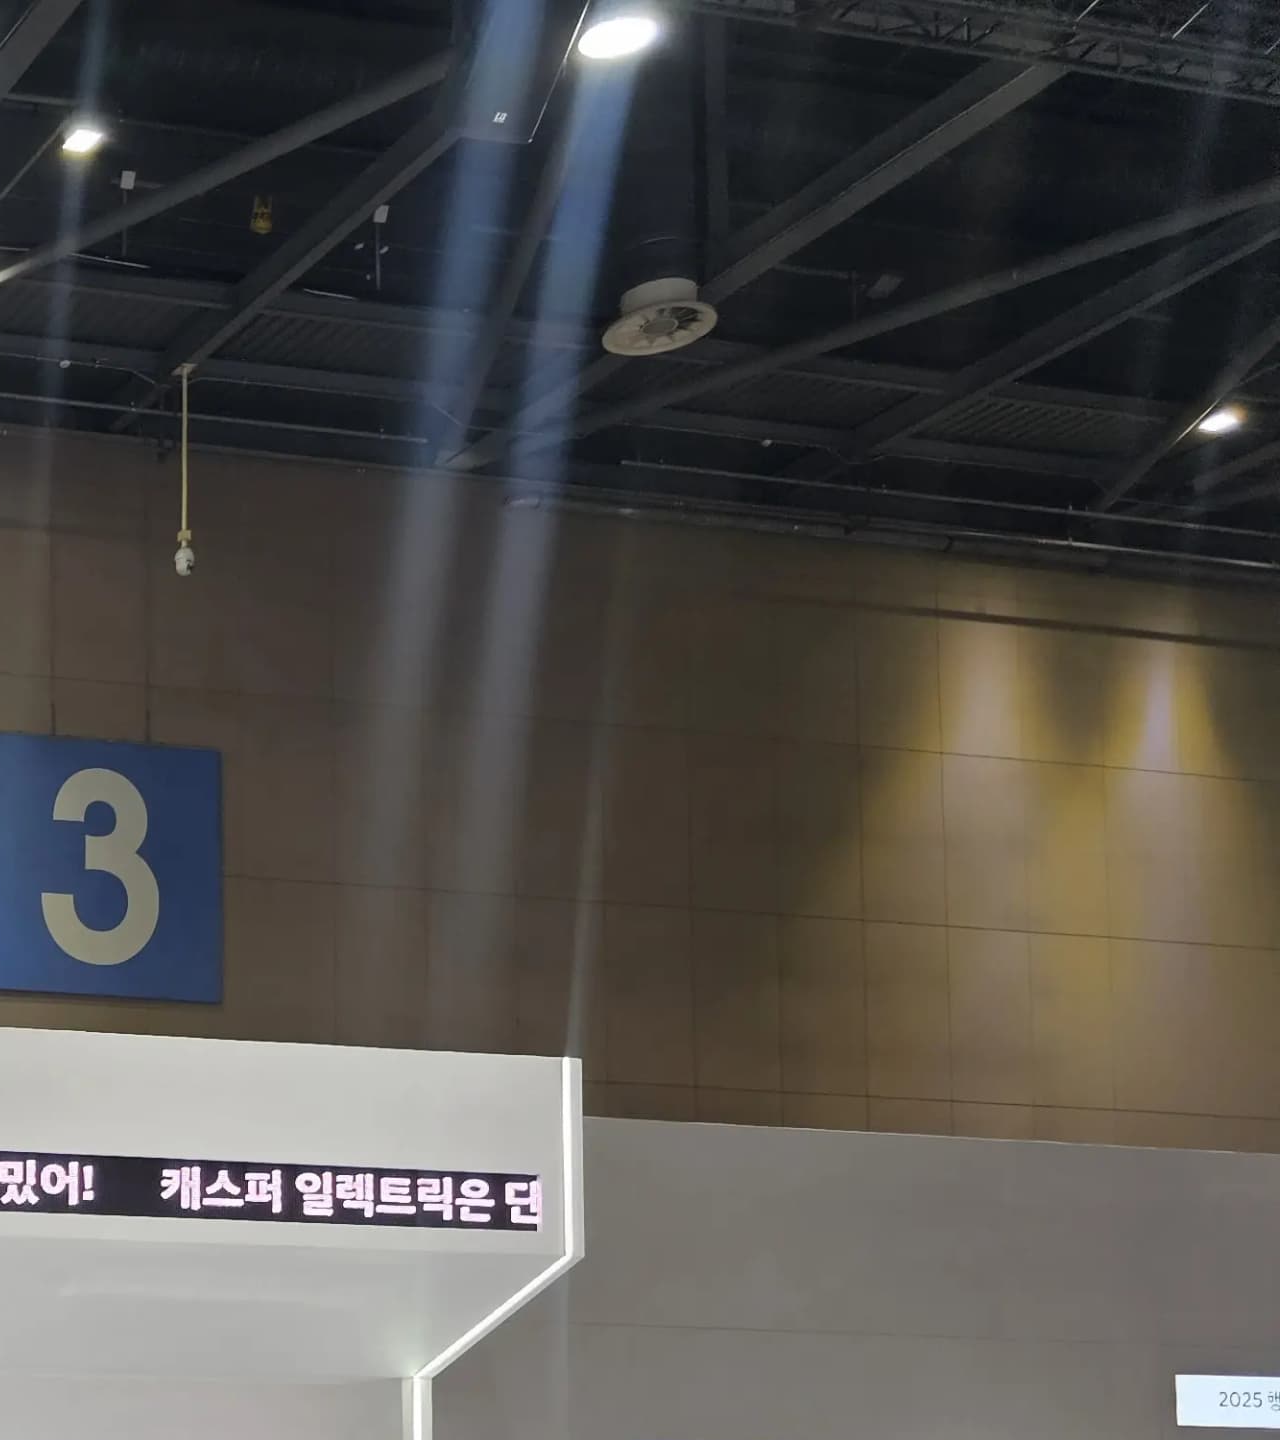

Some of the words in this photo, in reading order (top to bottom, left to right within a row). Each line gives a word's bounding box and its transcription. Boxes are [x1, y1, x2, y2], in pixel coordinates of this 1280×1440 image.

[41, 767, 160, 966] 3
[159, 1165, 282, 1214] 캐스퍼
[294, 1171, 496, 1223] 일렉트릭은
[1218, 1391, 1263, 1408] 2025
